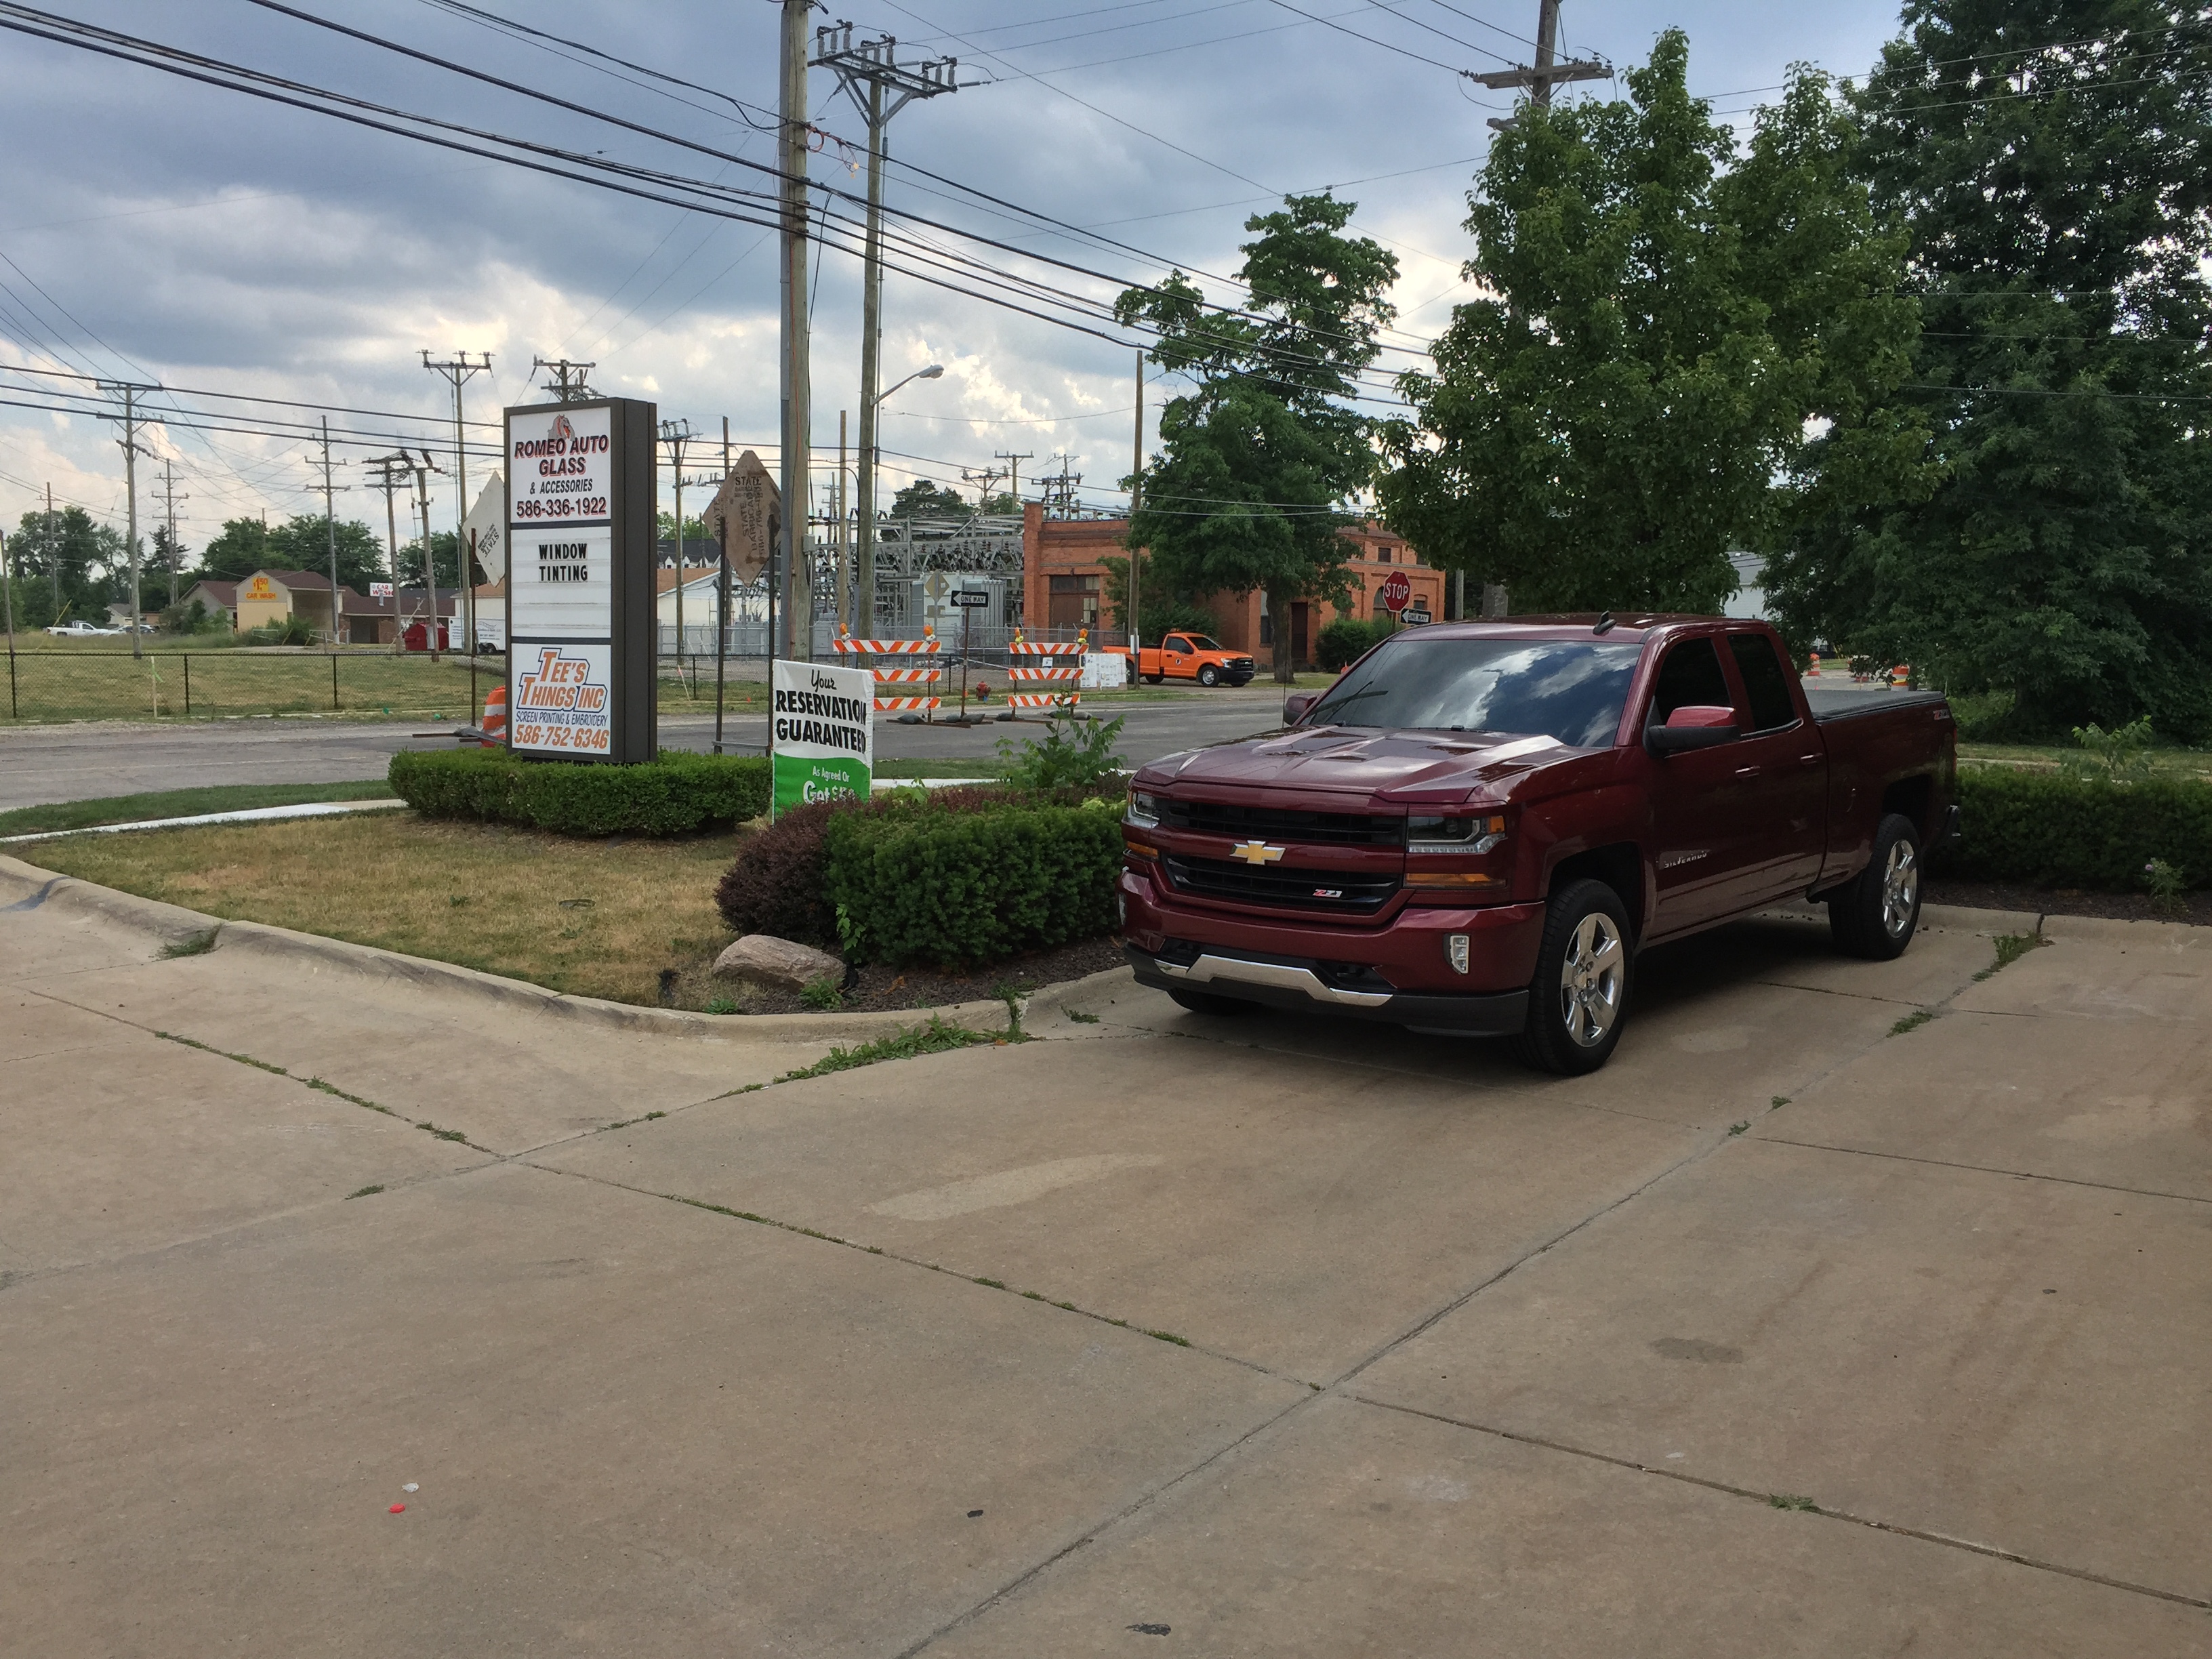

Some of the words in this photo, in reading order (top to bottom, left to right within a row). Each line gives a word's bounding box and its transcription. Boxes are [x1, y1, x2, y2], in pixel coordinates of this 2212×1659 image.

[514, 438, 567, 459] ROMEO
[569, 434, 609, 455] AUTO
[539, 457, 587, 476] GLASS
[529, 481, 535, 495] &
[539, 478, 593, 495] ACCESSORIES
[516, 497, 607, 518] 586-336-1922
[740, 502, 749, 537] STATE
[538, 543, 588, 560] WINDOW
[539, 565, 588, 581] TINTING
[1385, 582, 1409, 600] STOP
[811, 669, 837, 693] Your
[521, 676, 577, 708] THINGS
[516, 710, 538, 722] SCREEN
[539, 712, 565, 724] PRINTING
[565, 713, 570, 724] &
[571, 714, 608, 726] EMBROIDERY
[776, 690, 867, 726] RESERVATION
[514, 724, 610, 749] 586-752-6346
[776, 718, 866, 754] GUARANTEED
[813, 765, 820, 777] As
[821, 767, 841, 781] Agreed
[842, 771, 850, 782] Or
[803, 780, 830, 806] Get
[1313, 888, 1343, 898] Z71
